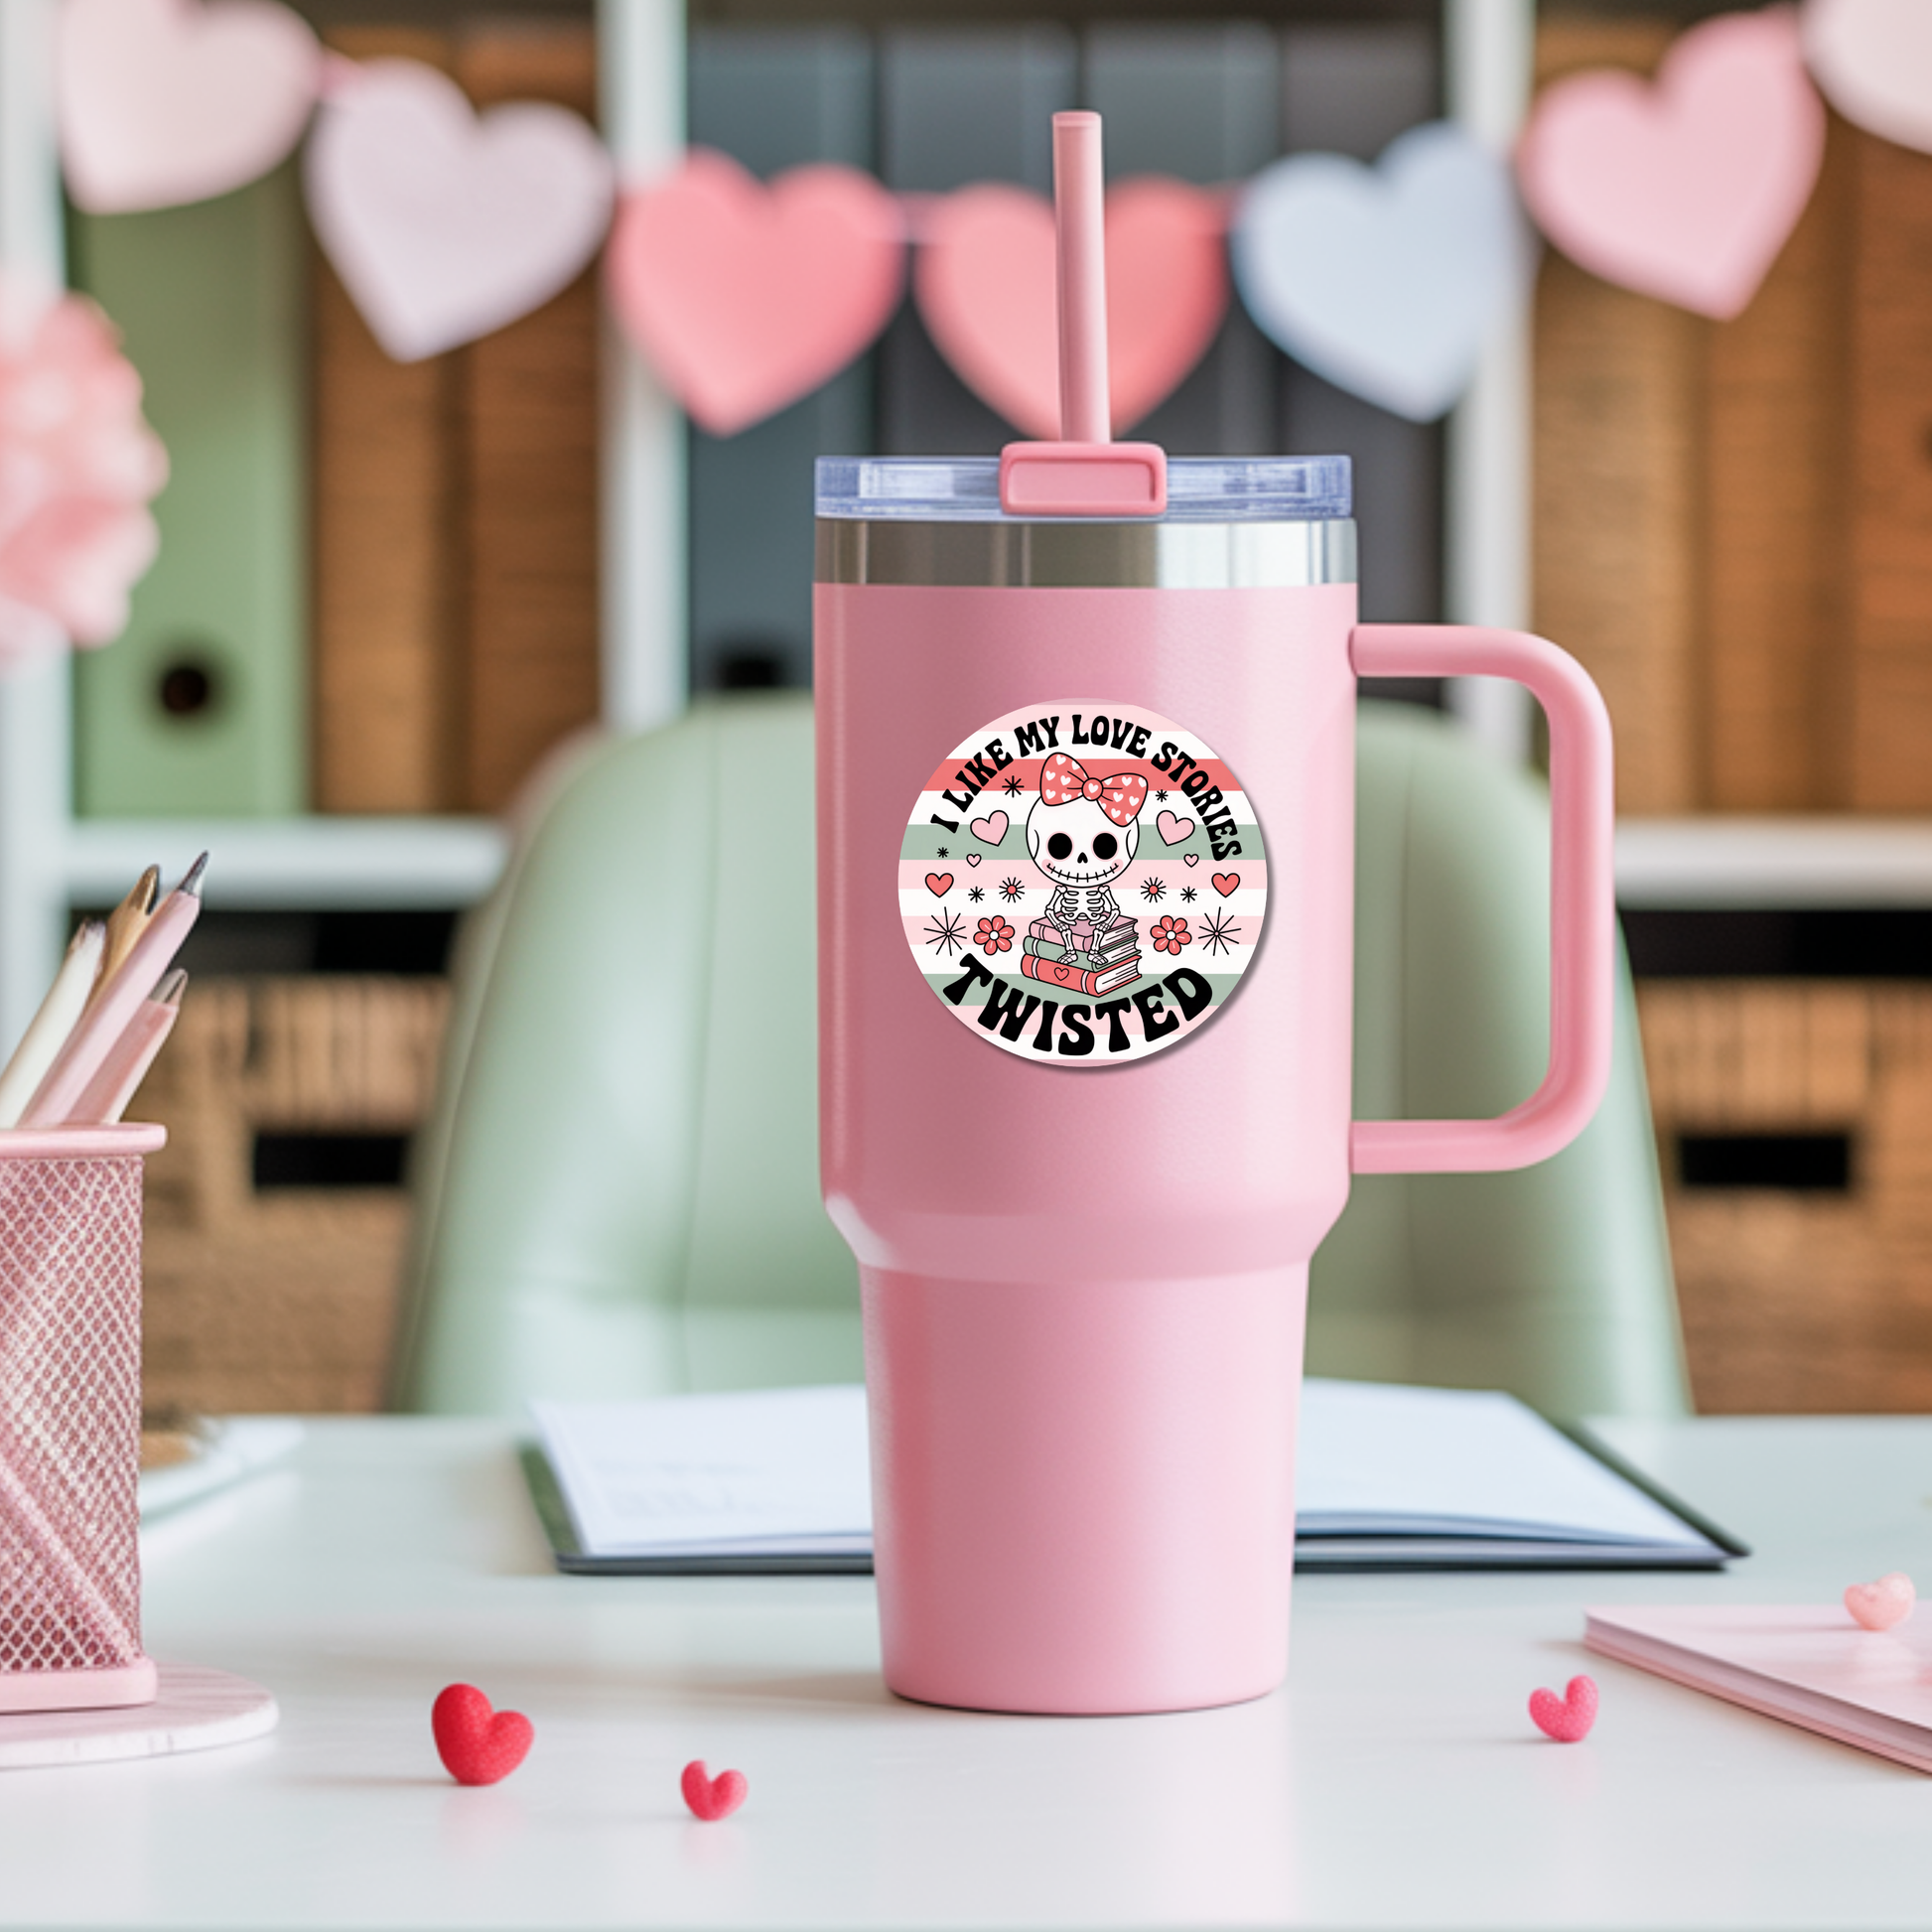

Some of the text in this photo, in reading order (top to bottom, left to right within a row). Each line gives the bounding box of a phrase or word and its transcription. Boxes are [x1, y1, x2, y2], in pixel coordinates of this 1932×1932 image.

[929, 714, 1243, 862] I LIKE MY LOVE STORIES
[942, 952, 1213, 1056] TWISTED
